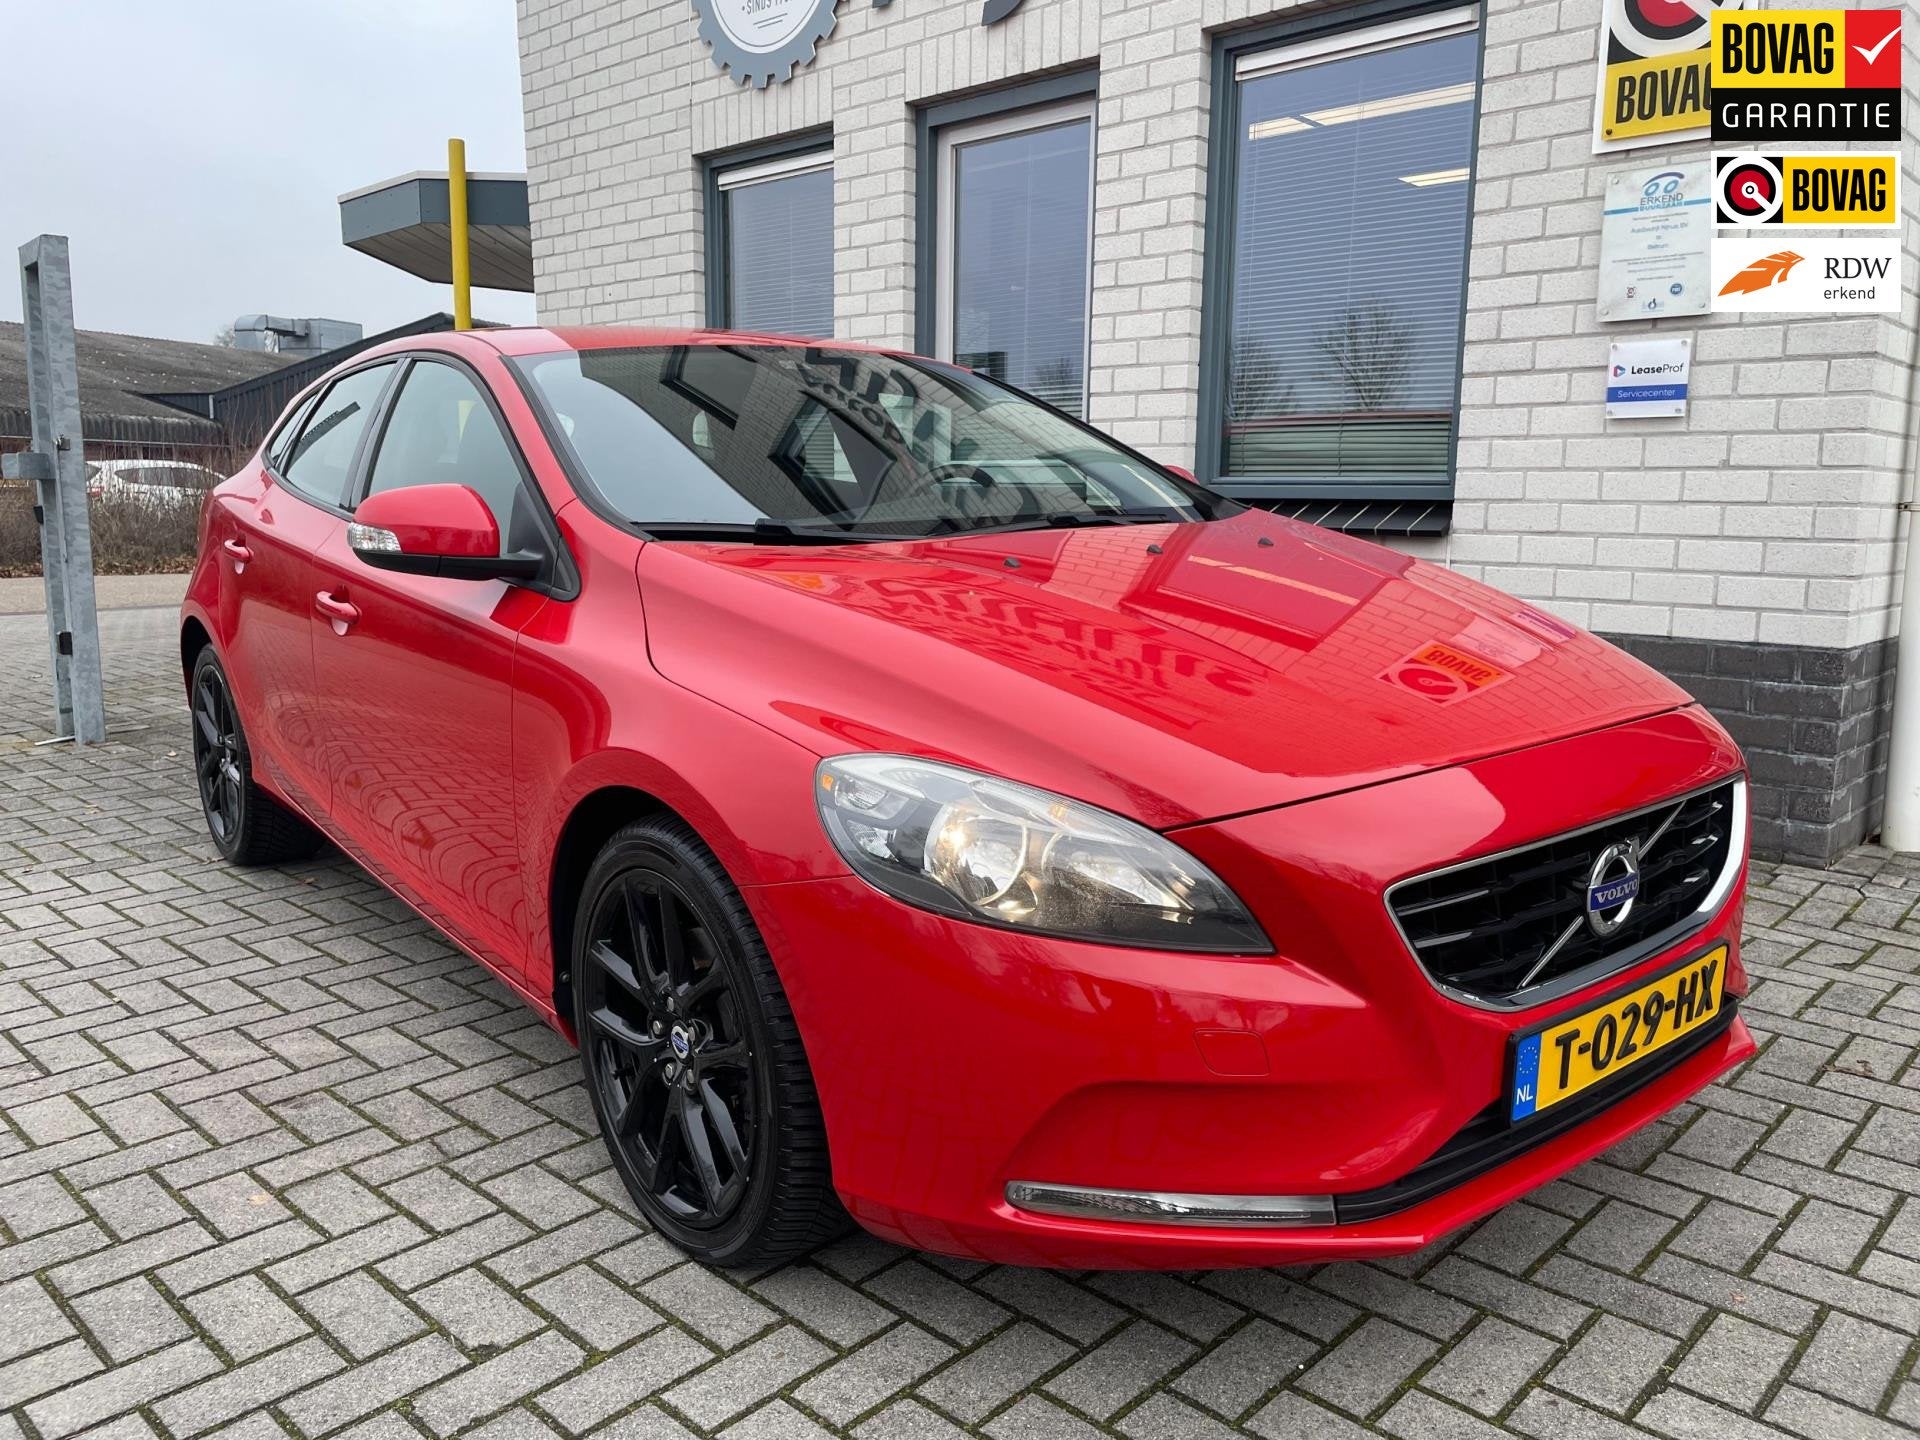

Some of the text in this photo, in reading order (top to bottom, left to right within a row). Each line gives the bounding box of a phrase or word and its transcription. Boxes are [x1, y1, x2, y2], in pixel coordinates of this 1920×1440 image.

[1640, 192, 1684, 206] ERKEND
[1631, 362, 1684, 375] LeaseProf
[1617, 389, 1676, 399] Servicecenter
[1595, 879, 1637, 904] VOLVO
[1555, 959, 1718, 1090] T-029-HX
[1515, 1084, 1534, 1106] NL
